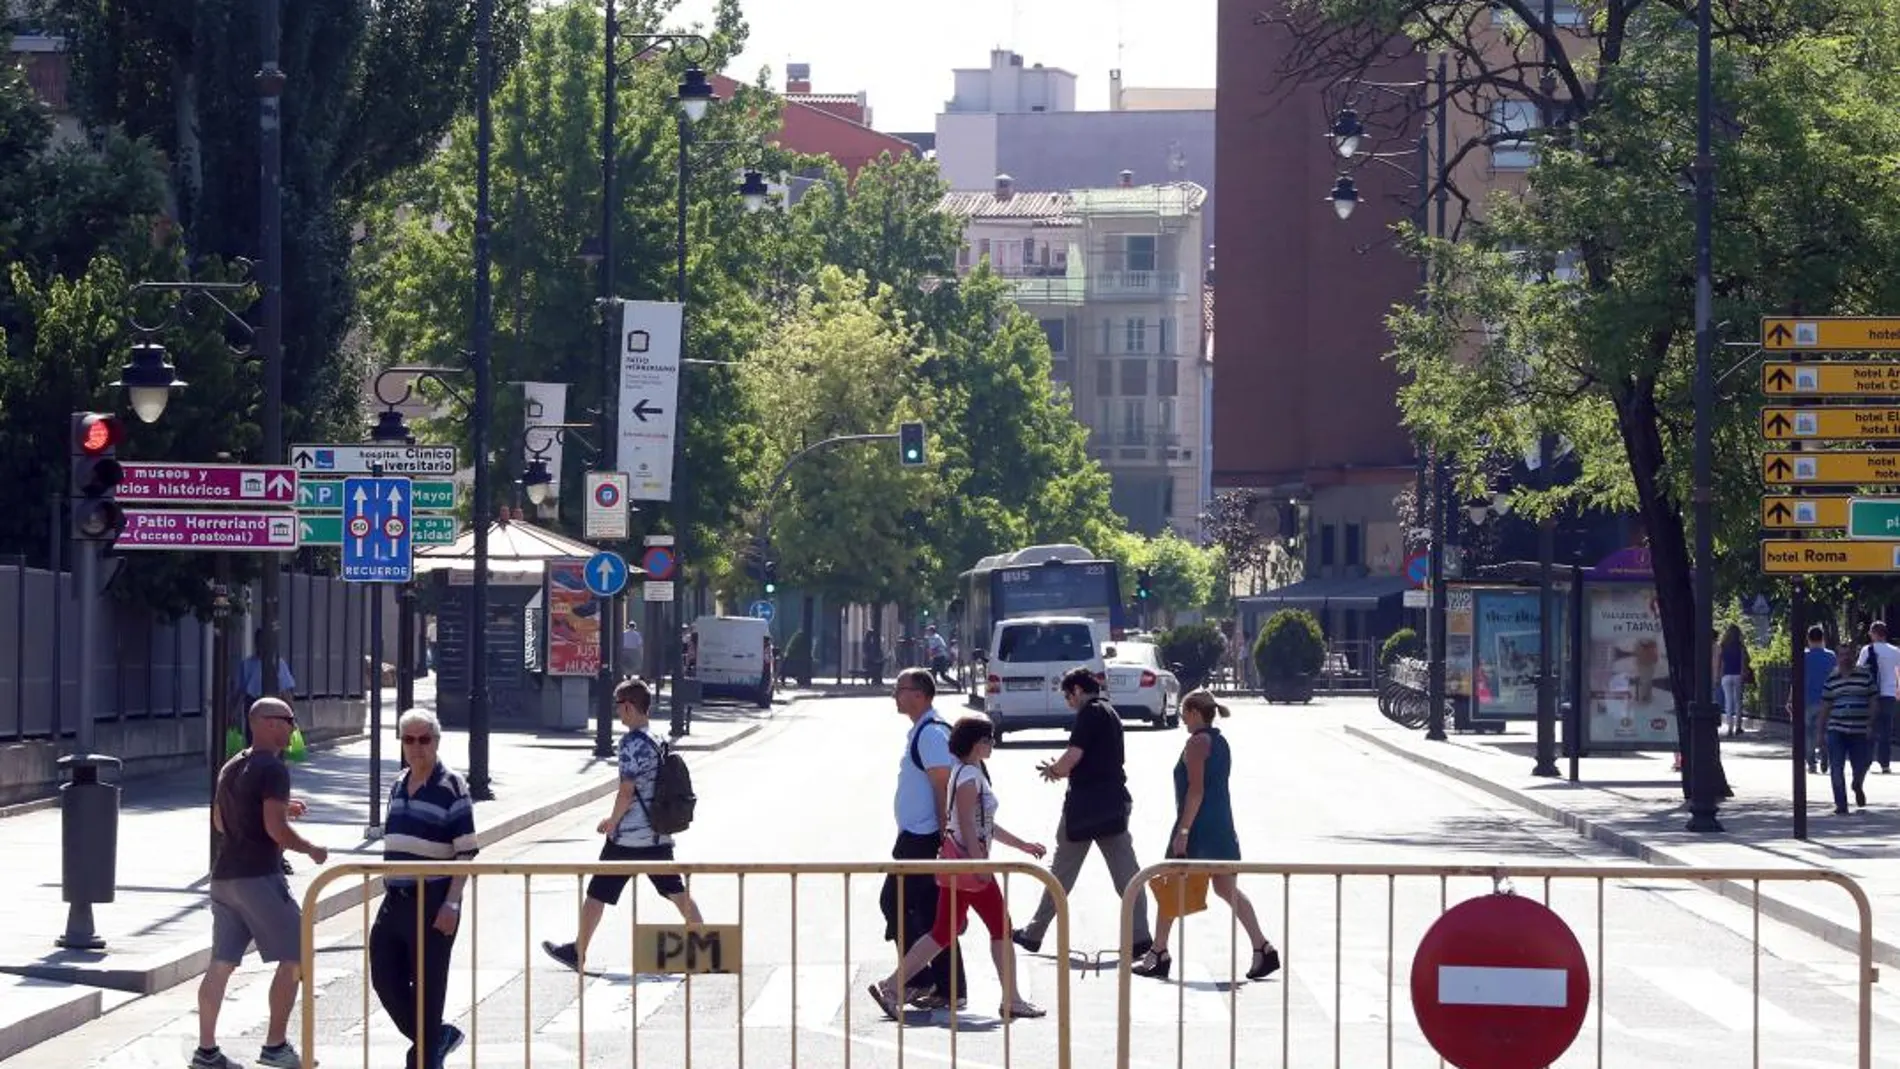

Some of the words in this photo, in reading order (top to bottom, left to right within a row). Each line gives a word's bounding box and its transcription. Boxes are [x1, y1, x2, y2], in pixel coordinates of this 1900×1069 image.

[1854, 368, 1881, 378] hotel
[1857, 381, 1884, 390] hotel
[1856, 412, 1883, 421] hotel
[1861, 424, 1888, 434] hotel
[360, 450, 400, 460] hospital
[365, 461, 452, 471] Uiversitario
[1868, 456, 1895, 466] hotel
[135, 469, 190, 479] museos
[199, 470, 208, 481] y
[1875, 469, 1900, 478] hote
[116, 482, 150, 494] icios
[159, 482, 231, 496] históricos
[412, 490, 452, 504] Mayor
[137, 515, 176, 528] Patio
[426, 519, 437, 528] de
[443, 519, 452, 528] la
[1886, 516, 1900, 530] pl
[133, 529, 184, 542] (acceso
[192, 530, 254, 543] peatonal)
[412, 529, 452, 540] rsidad
[1767, 551, 1799, 562] hotel
[1804, 549, 1848, 562] Roma
[346, 566, 408, 576] RECUERDE
[1002, 570, 1031, 582] BUS
[657, 930, 721, 970] PM
